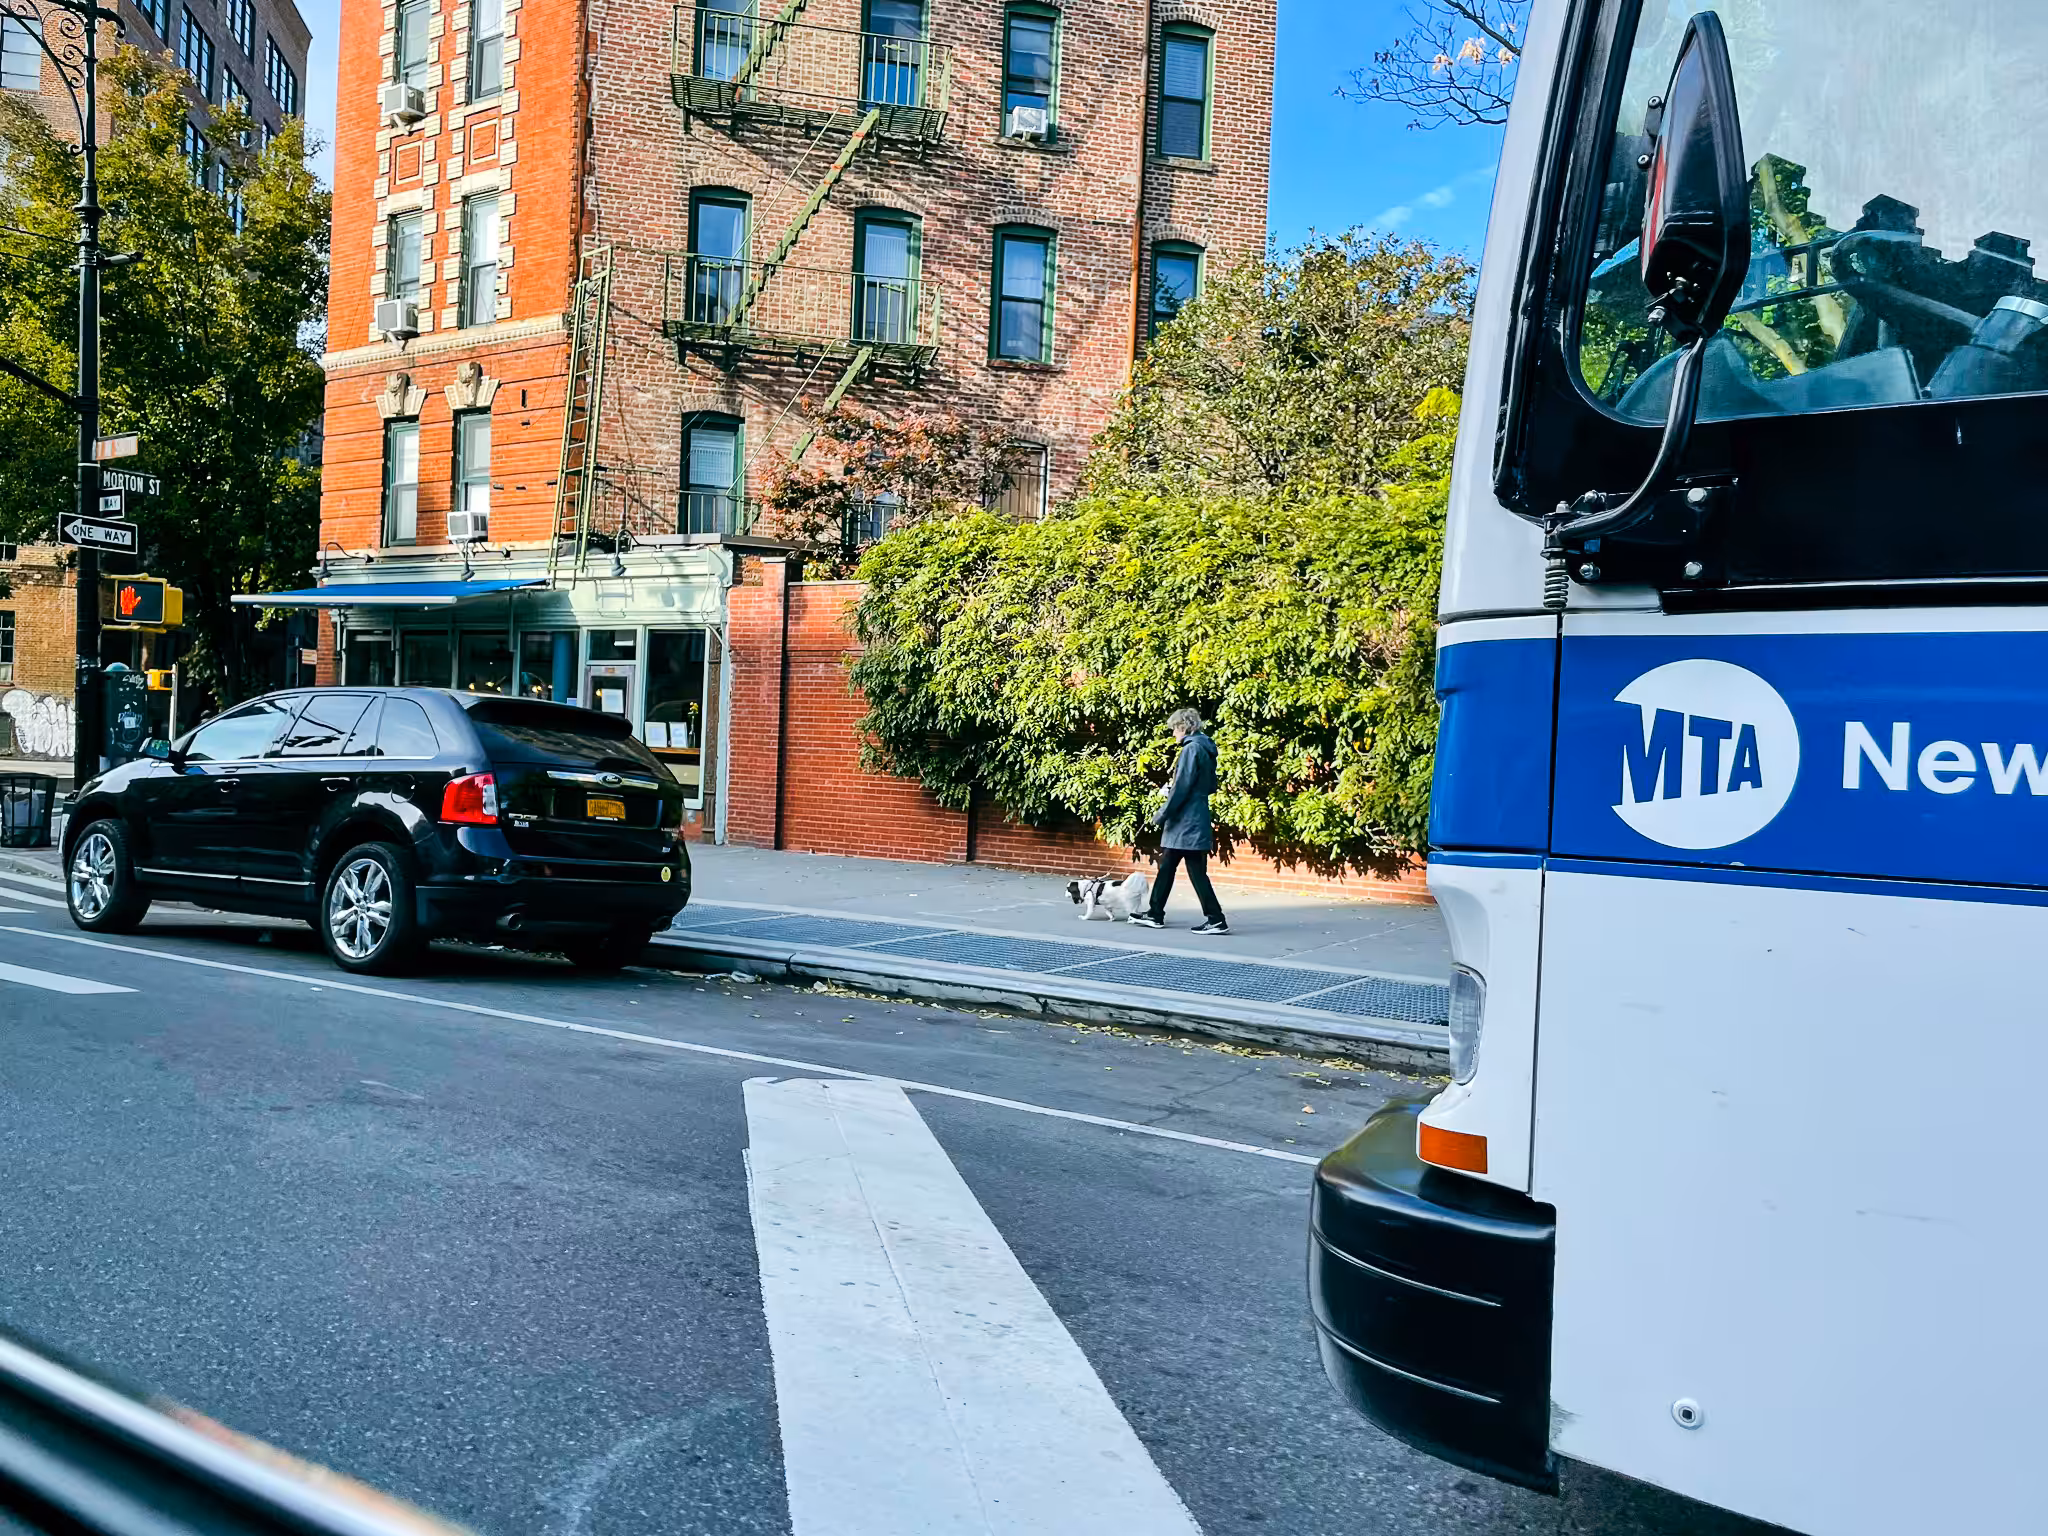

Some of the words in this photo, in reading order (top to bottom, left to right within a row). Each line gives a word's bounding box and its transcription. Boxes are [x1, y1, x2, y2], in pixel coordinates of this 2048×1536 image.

[103, 470, 144, 493] MORTON
[149, 479, 160, 496] ST
[104, 498, 118, 509] WAY
[72, 524, 94, 538] ONE
[104, 529, 127, 543] WAY
[1613, 700, 1763, 806] MTA
[1842, 720, 2048, 796] New
